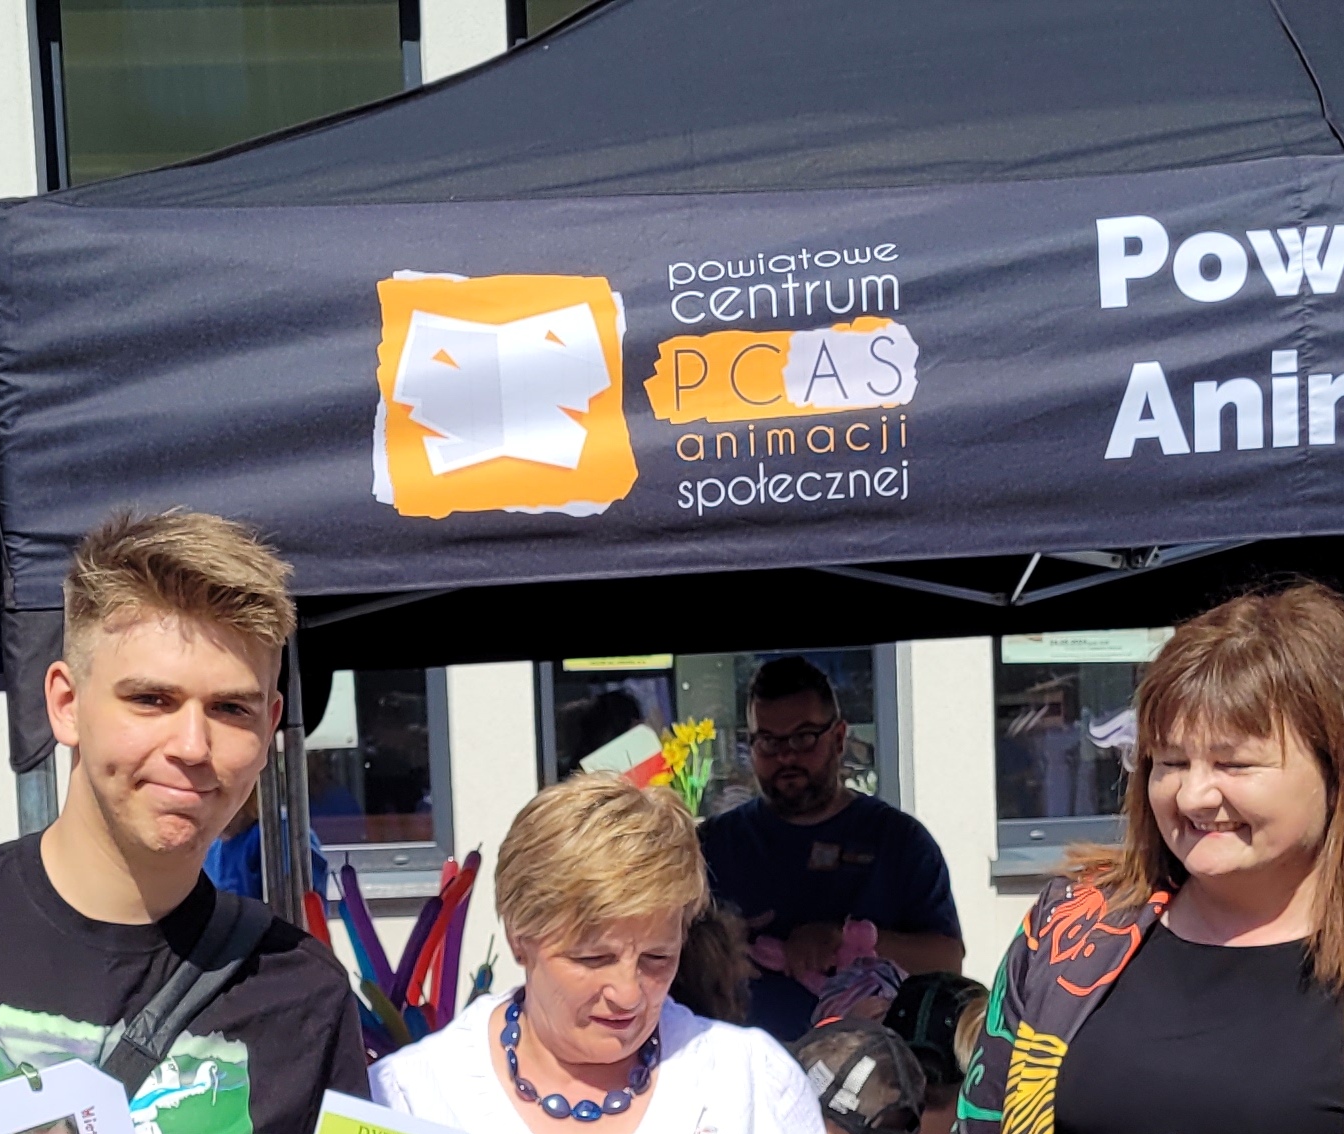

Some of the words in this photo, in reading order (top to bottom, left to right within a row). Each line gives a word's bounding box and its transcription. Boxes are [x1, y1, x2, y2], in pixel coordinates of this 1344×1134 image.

[668, 243, 900, 291] powiatowe
[670, 273, 900, 324] centrum
[674, 335, 903, 412] PCAS
[675, 413, 907, 462] animacji
[676, 459, 910, 517] społecznej
